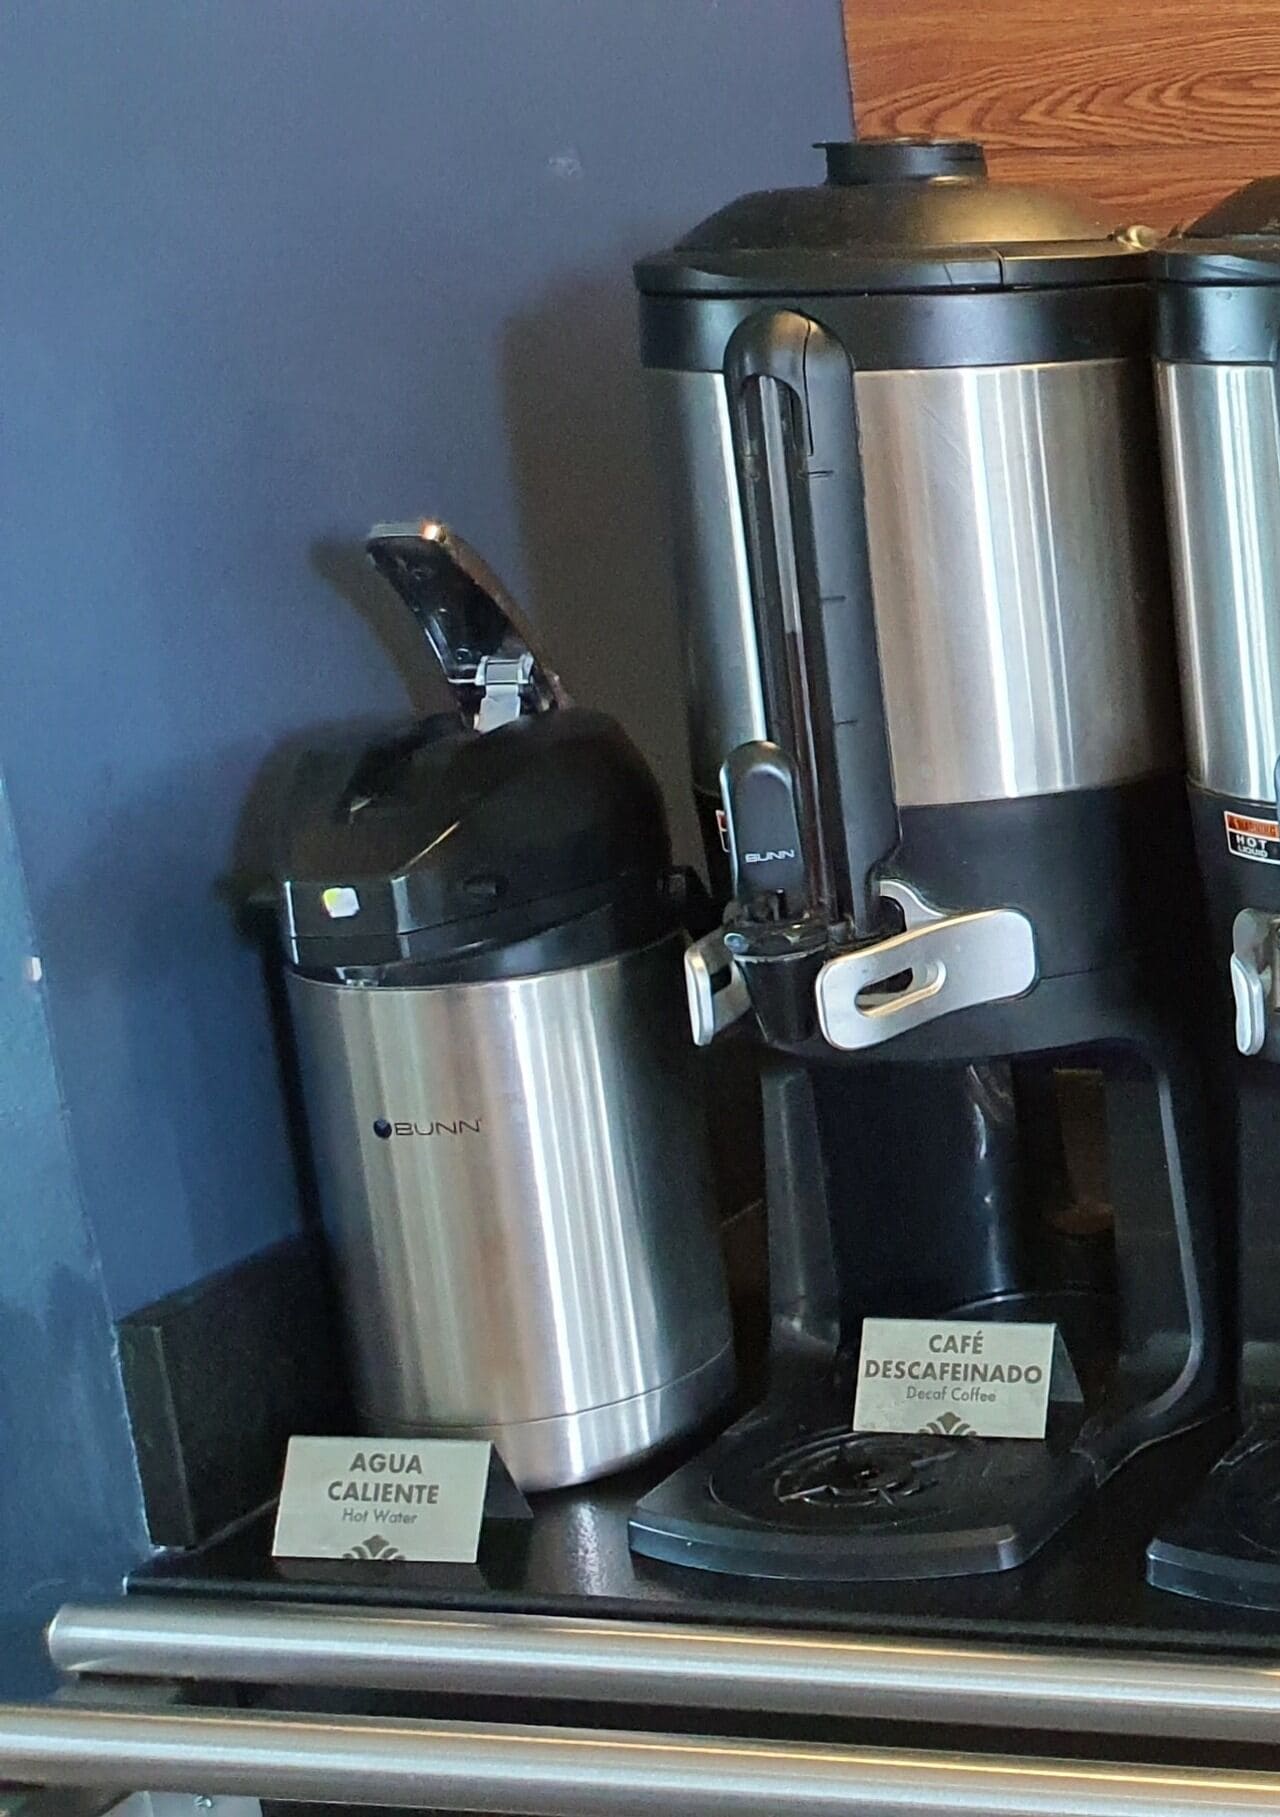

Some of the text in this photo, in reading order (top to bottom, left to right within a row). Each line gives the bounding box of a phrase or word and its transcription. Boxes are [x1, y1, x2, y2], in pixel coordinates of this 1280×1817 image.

[1236, 834, 1267, 850] HOT
[745, 850, 795, 863] BUNN
[394, 1119, 480, 1136] BUNN
[929, 1330, 984, 1355] CAFÉ
[864, 1360, 1043, 1385] DESCAFEINADO
[906, 1386, 997, 1403] Decaf Coffee
[350, 1452, 423, 1475] AGUA
[328, 1481, 440, 1505] CALIENTE
[342, 1508, 418, 1525] Hot Water
